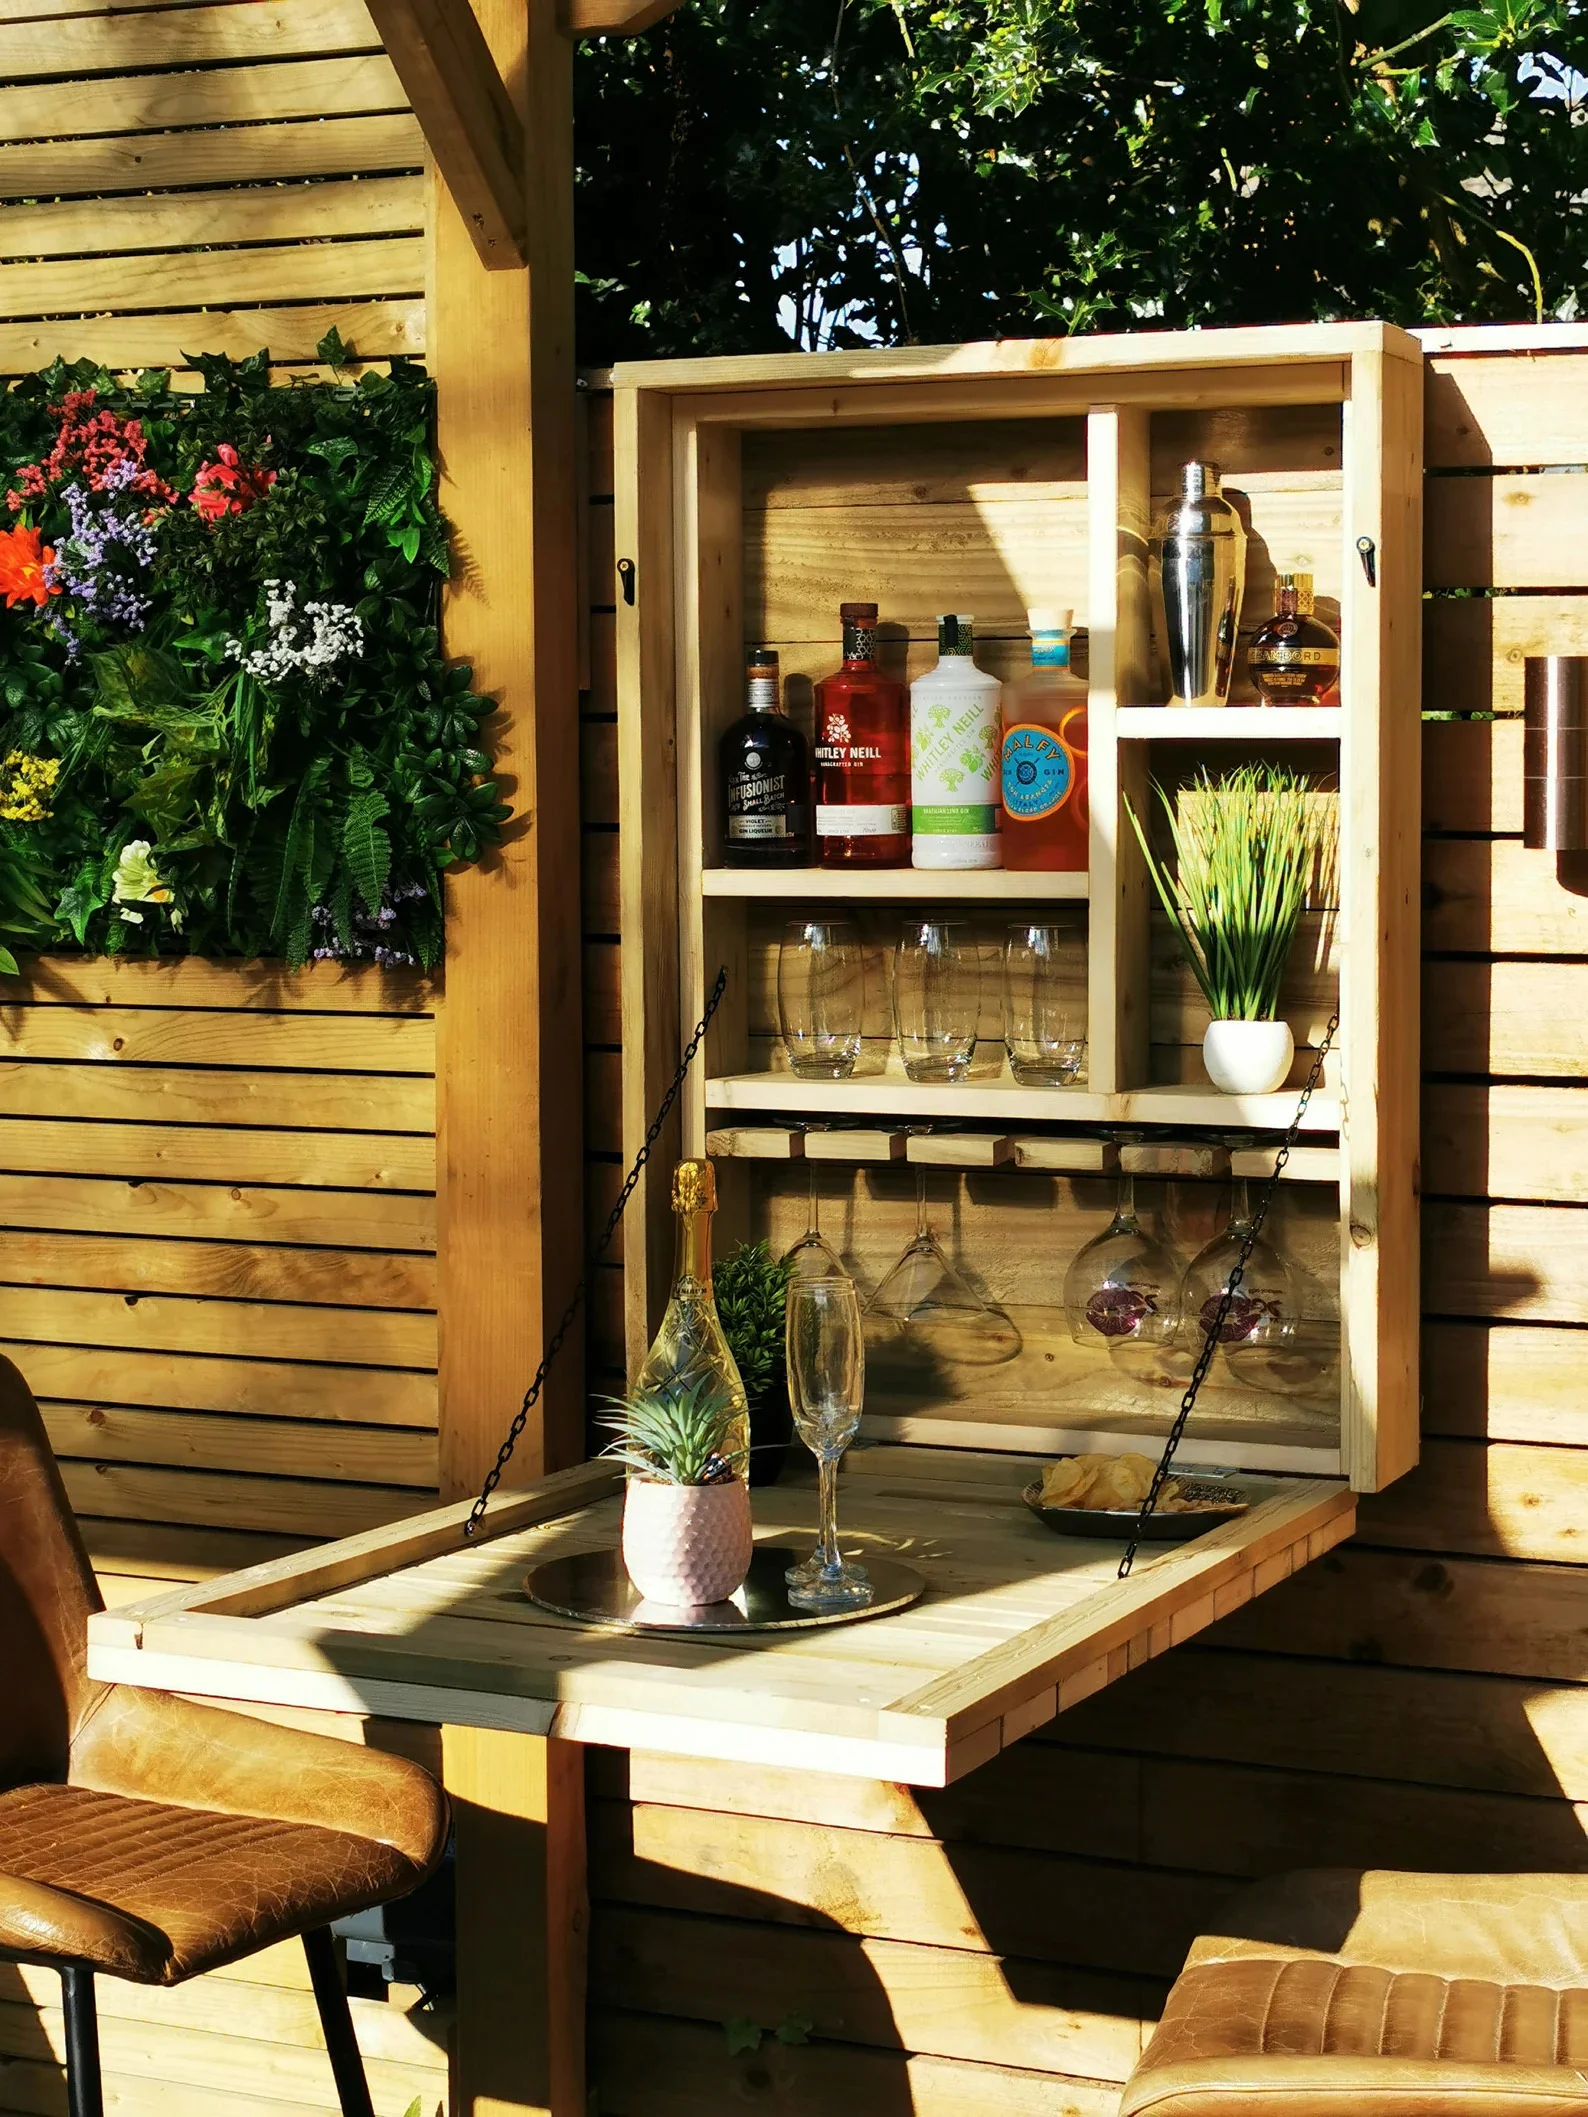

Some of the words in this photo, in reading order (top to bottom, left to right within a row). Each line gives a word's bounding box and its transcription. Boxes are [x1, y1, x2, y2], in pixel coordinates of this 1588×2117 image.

[850, 747, 881, 758] NEILL
[915, 732, 955, 780] WHITLEY
[952, 703, 984, 736] NEILL
[1003, 734, 1061, 762] MALFY
[1043, 768, 1065, 776] GIN
[728, 775, 785, 808] INFUSIONIST
